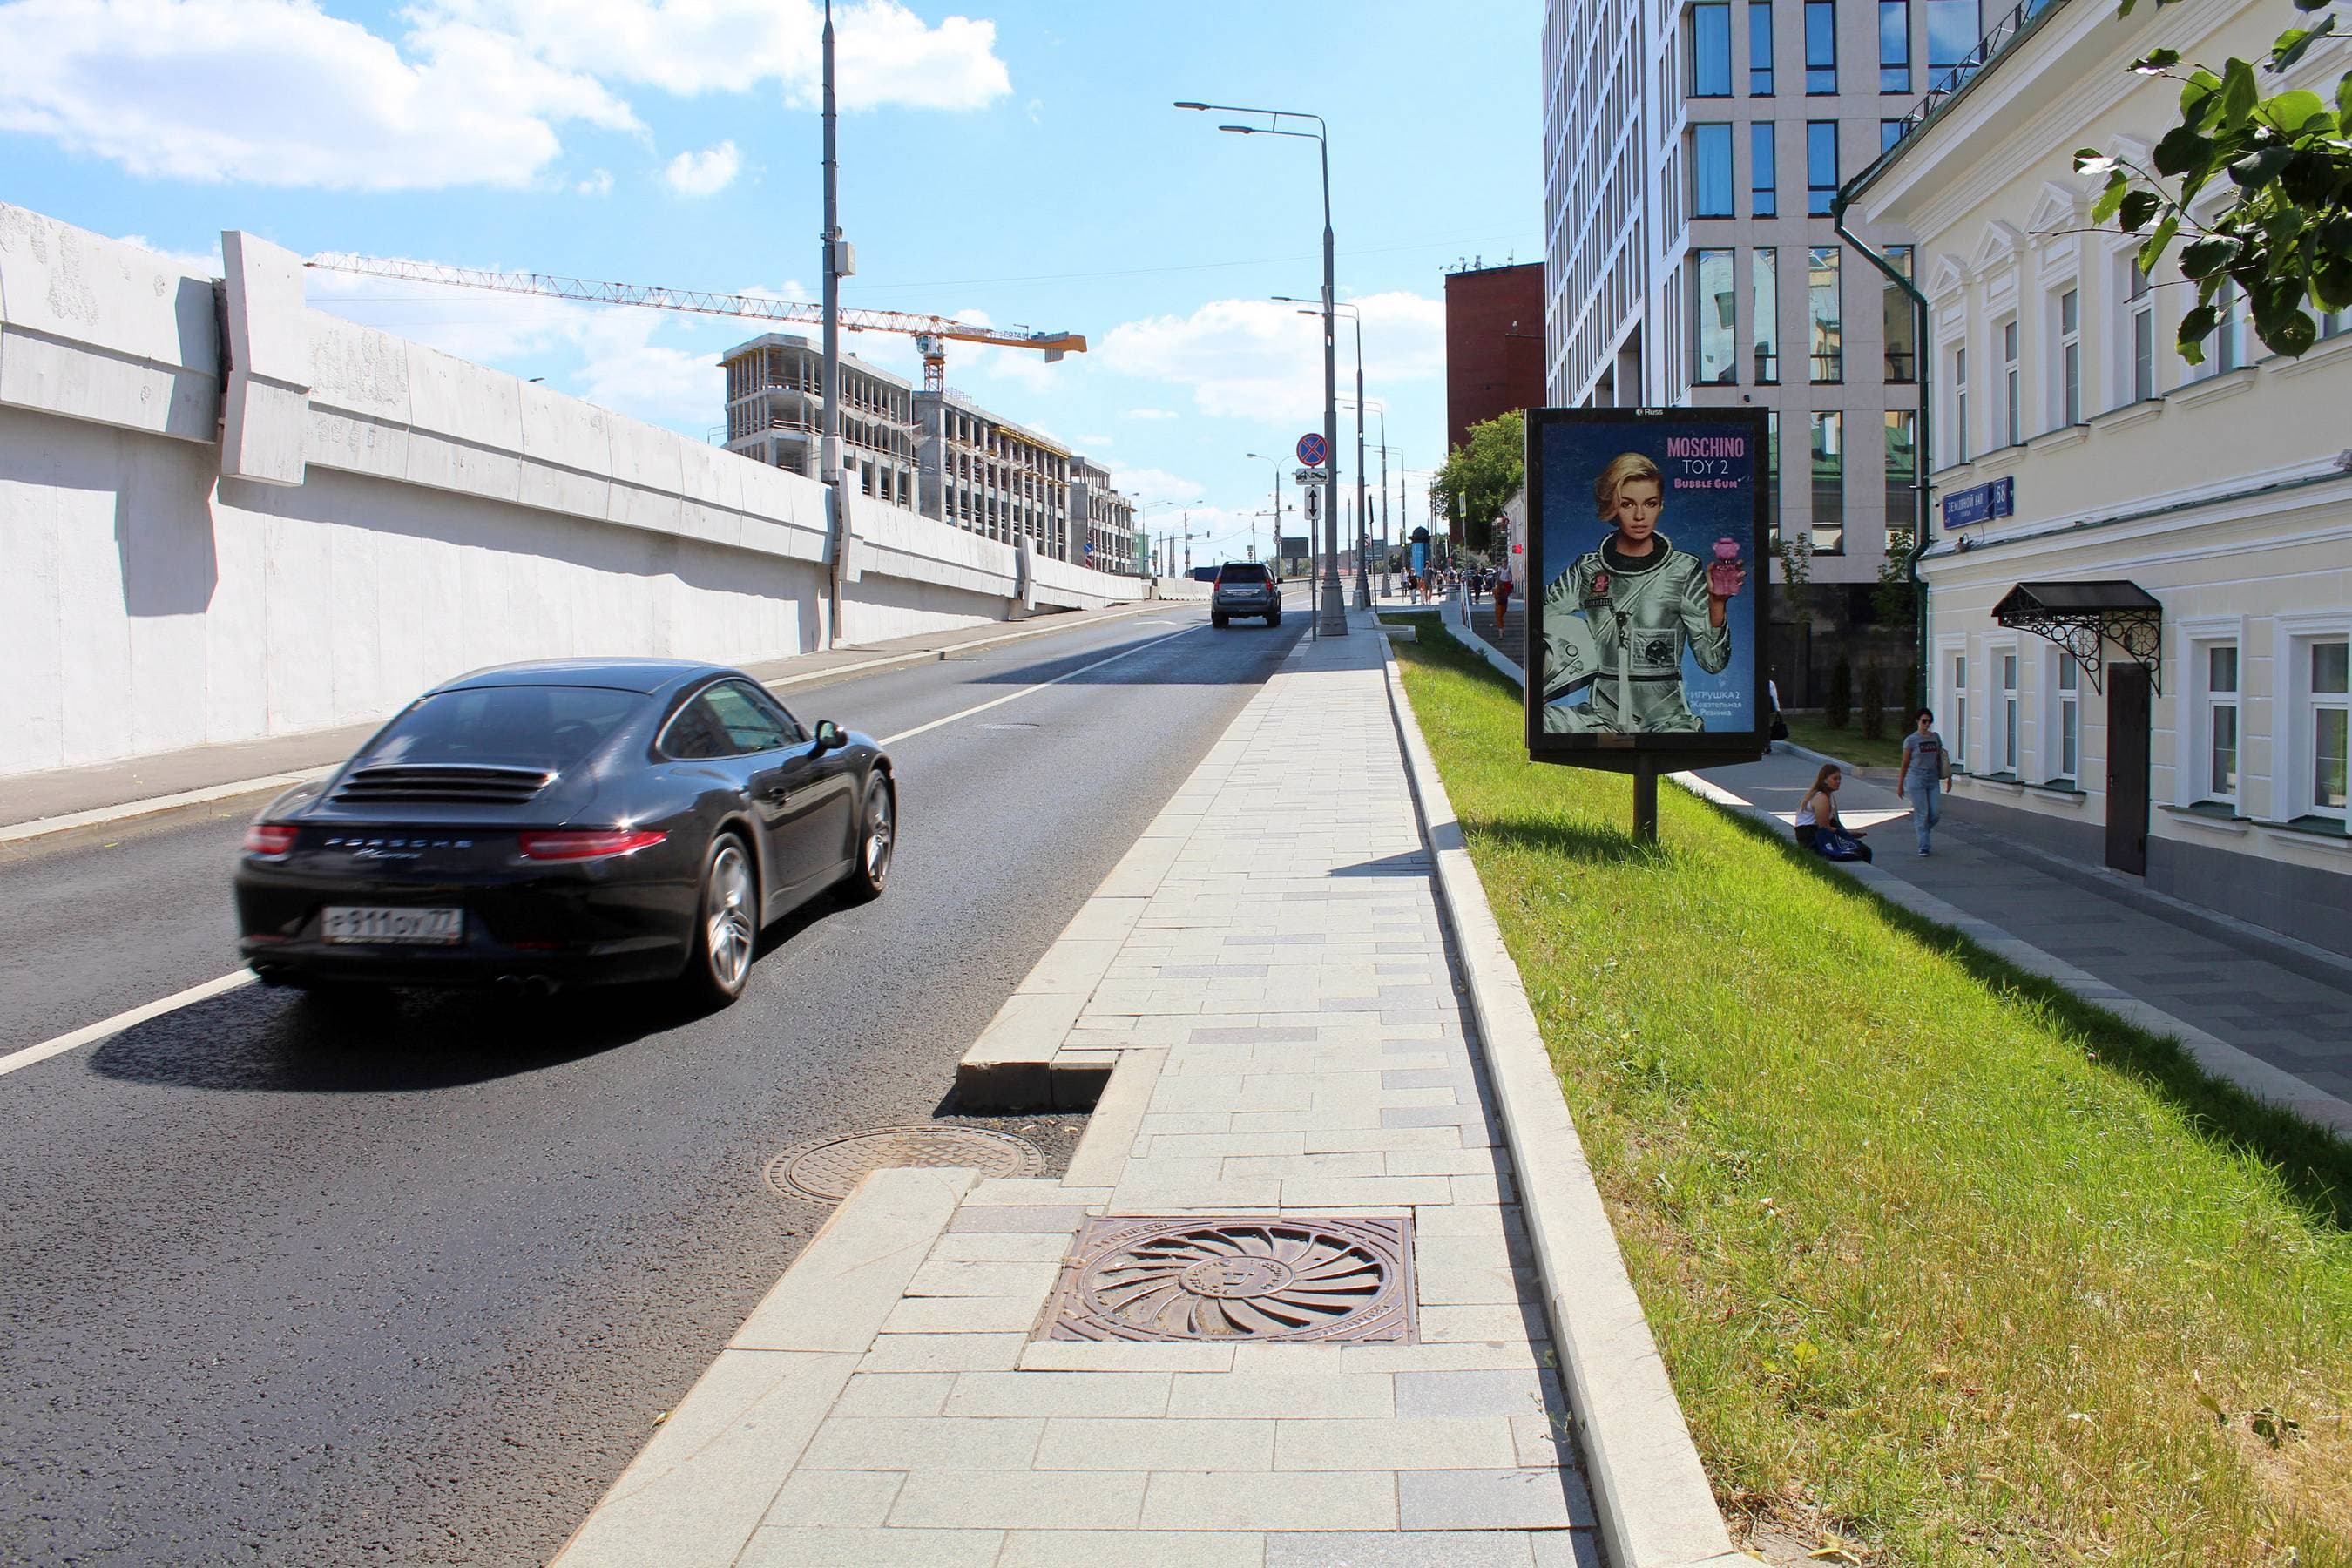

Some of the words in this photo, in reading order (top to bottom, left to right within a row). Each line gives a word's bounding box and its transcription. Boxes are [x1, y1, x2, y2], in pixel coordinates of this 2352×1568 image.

[1666, 437, 1745, 458] MOSCHINO
[1682, 459, 1714, 475] TOY
[1720, 459, 1729, 475] 2
[1996, 484, 2006, 504] 68
[1690, 691, 1734, 700] ИГРУШКА
